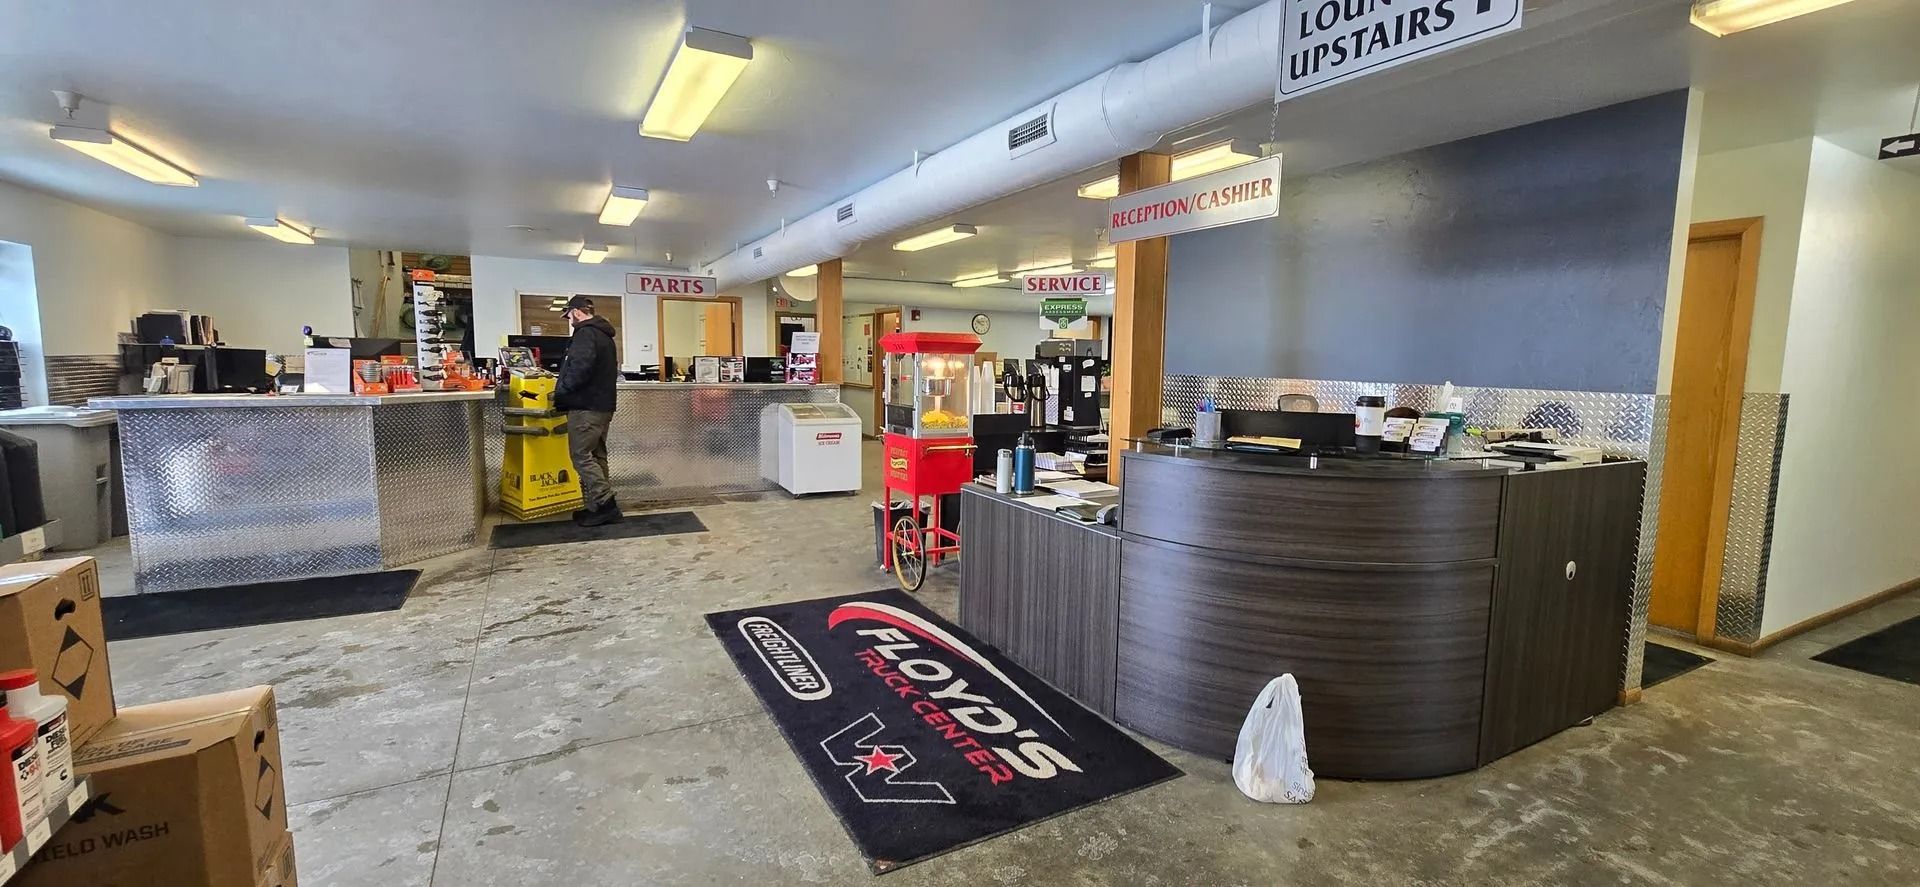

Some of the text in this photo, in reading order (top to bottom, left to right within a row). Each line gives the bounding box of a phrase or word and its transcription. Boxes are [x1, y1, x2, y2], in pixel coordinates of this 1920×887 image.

[1289, 0, 1456, 81] UPSTAIRS
[1111, 176, 1273, 229] RECEPTION/CASHIER
[640, 276, 704, 294] PARTS
[1027, 276, 1101, 292] SERVICE
[530, 472, 552, 482] BLACK
[541, 479, 558, 488] JACK
[748, 623, 820, 692] FREIGHTLINER
[855, 648, 1014, 786] TRUCK CENTER
[856, 627, 1084, 780] FLOYD'S
[102, 821, 169, 849] WASH
